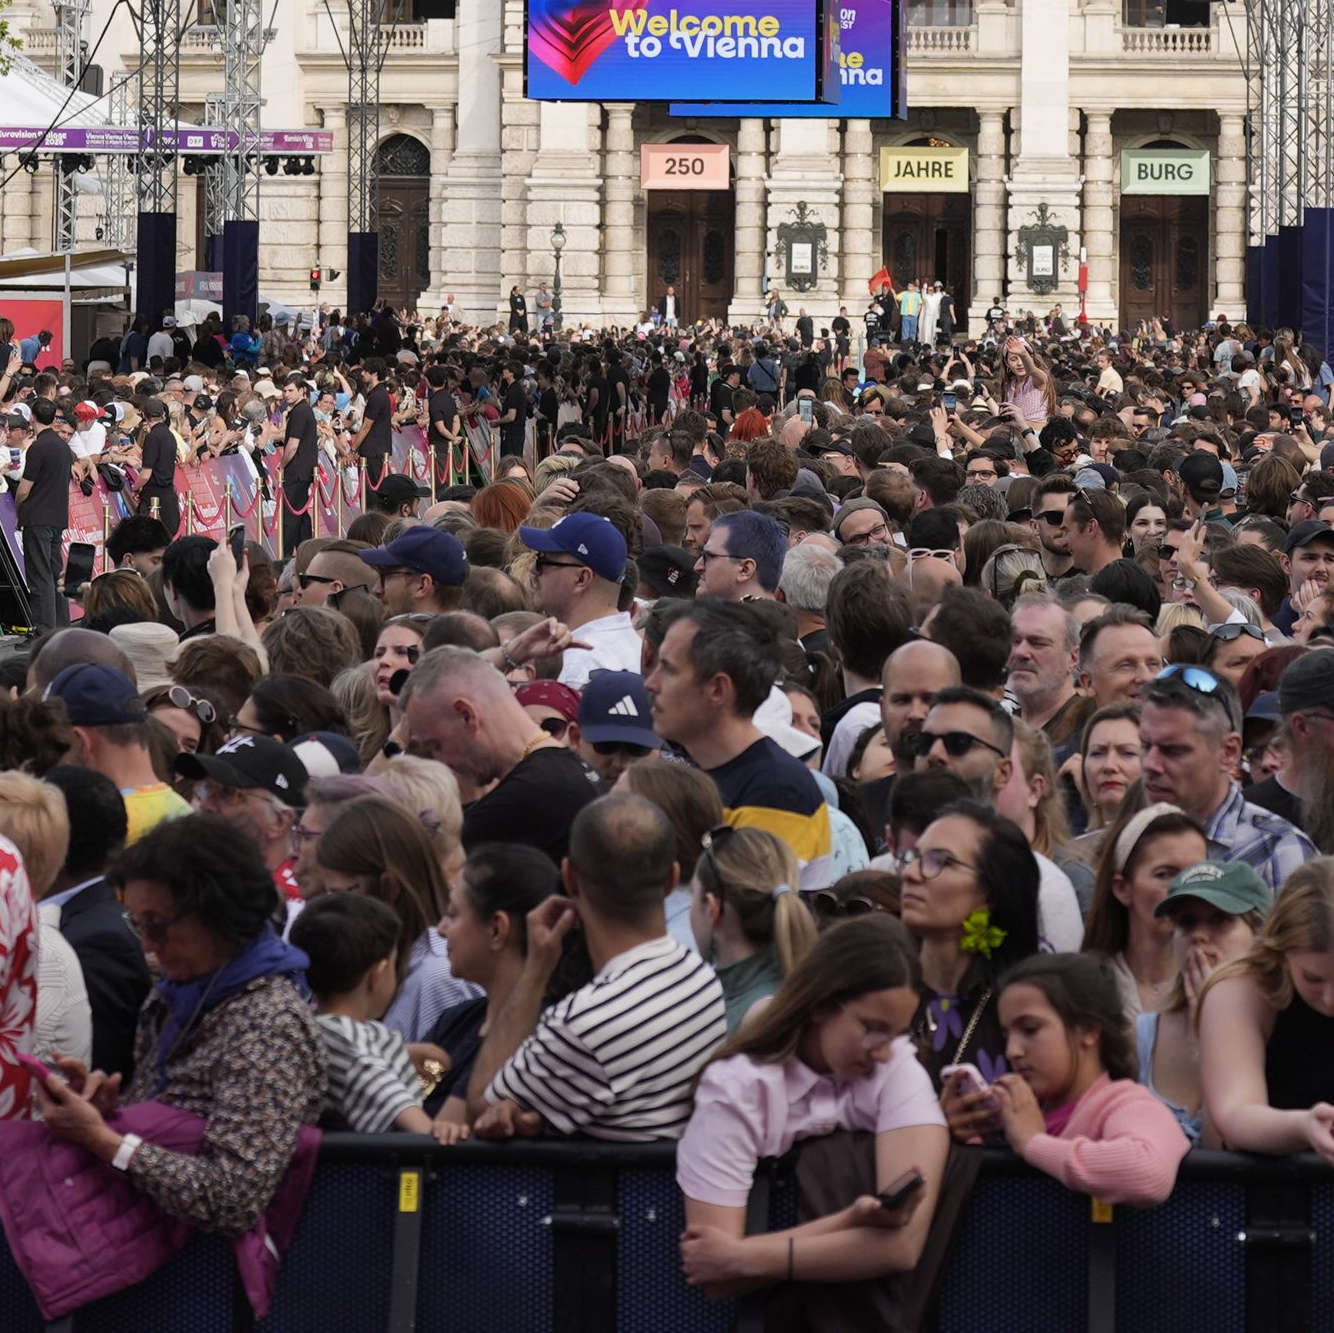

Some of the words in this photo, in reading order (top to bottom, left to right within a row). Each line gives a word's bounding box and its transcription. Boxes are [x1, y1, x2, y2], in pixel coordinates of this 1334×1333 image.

[609, 8, 780, 36] Welcome
[624, 32, 662, 59] to
[669, 30, 805, 59] Vienna
[44, 138, 64, 146] 2026
[664, 157, 705, 177] 250
[893, 159, 954, 180] JAHRE
[1136, 161, 1194, 182] BURG
